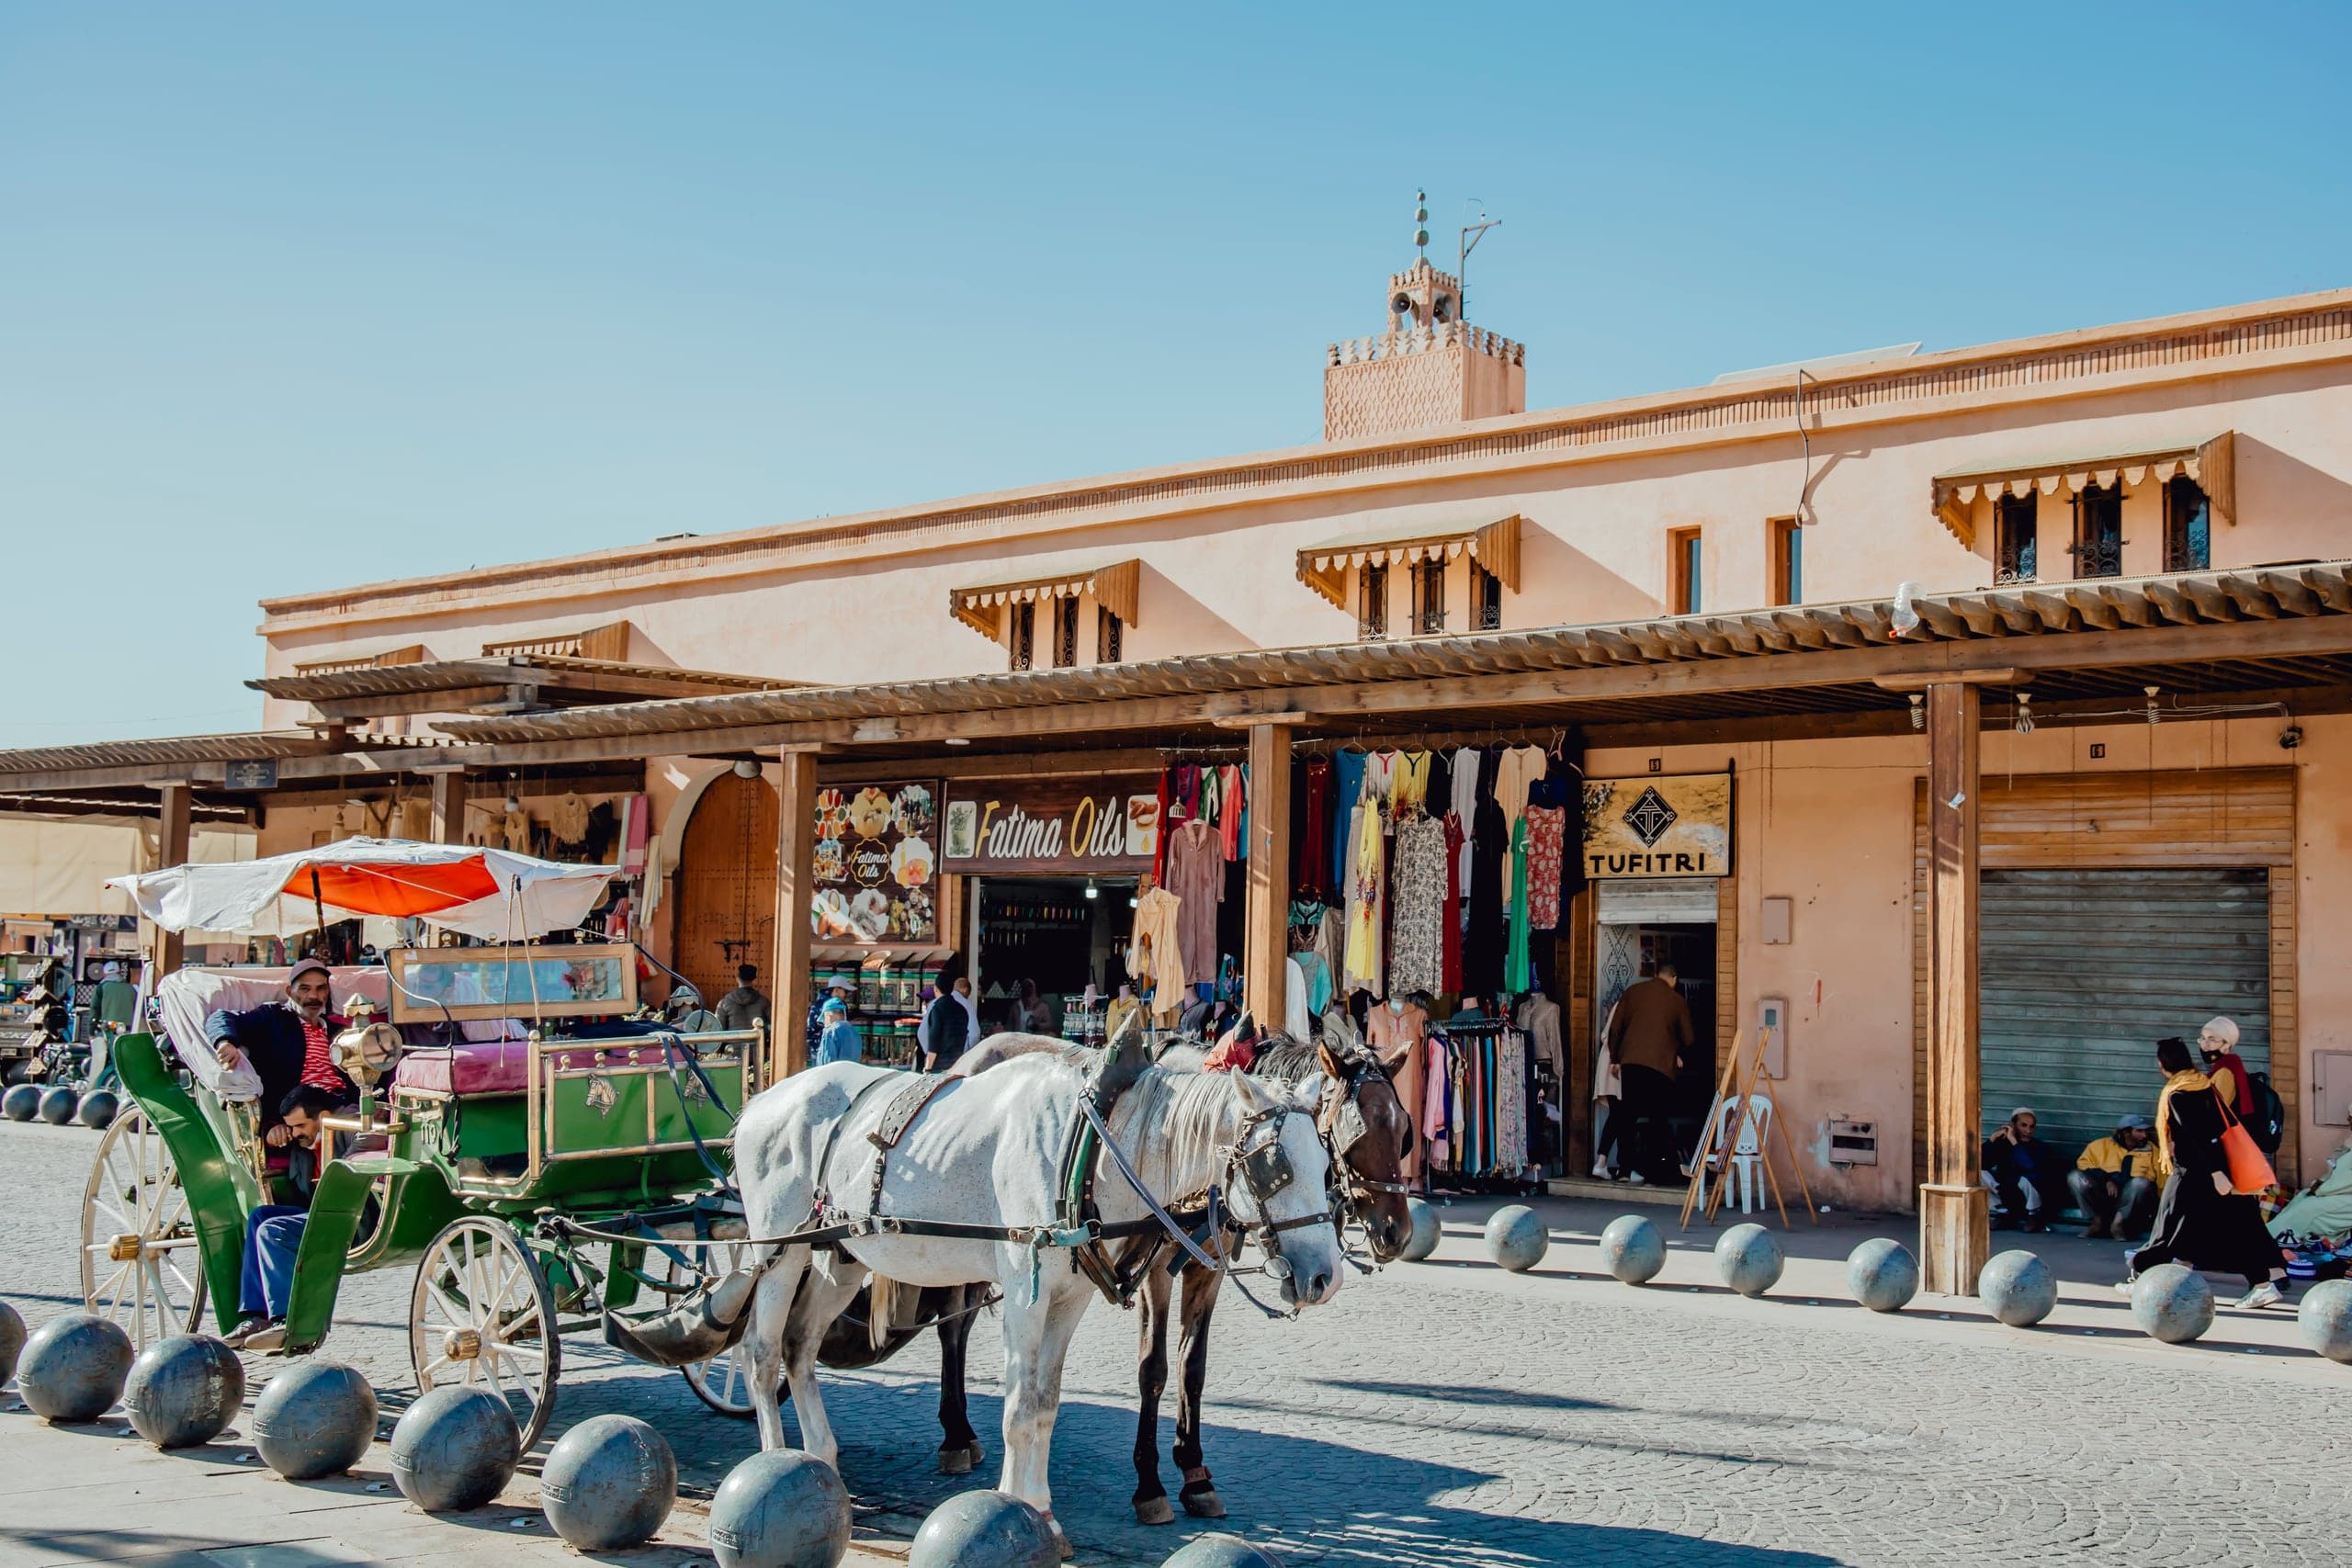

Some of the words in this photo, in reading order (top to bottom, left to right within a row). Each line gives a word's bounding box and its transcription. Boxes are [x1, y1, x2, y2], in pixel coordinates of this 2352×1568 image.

[976, 800, 1063, 859] Fatima
[1070, 796, 1125, 858] Oils
[852, 851, 888, 864] Fatima
[1589, 853, 1705, 874] TUFITRI
[857, 863, 879, 878] Oils
